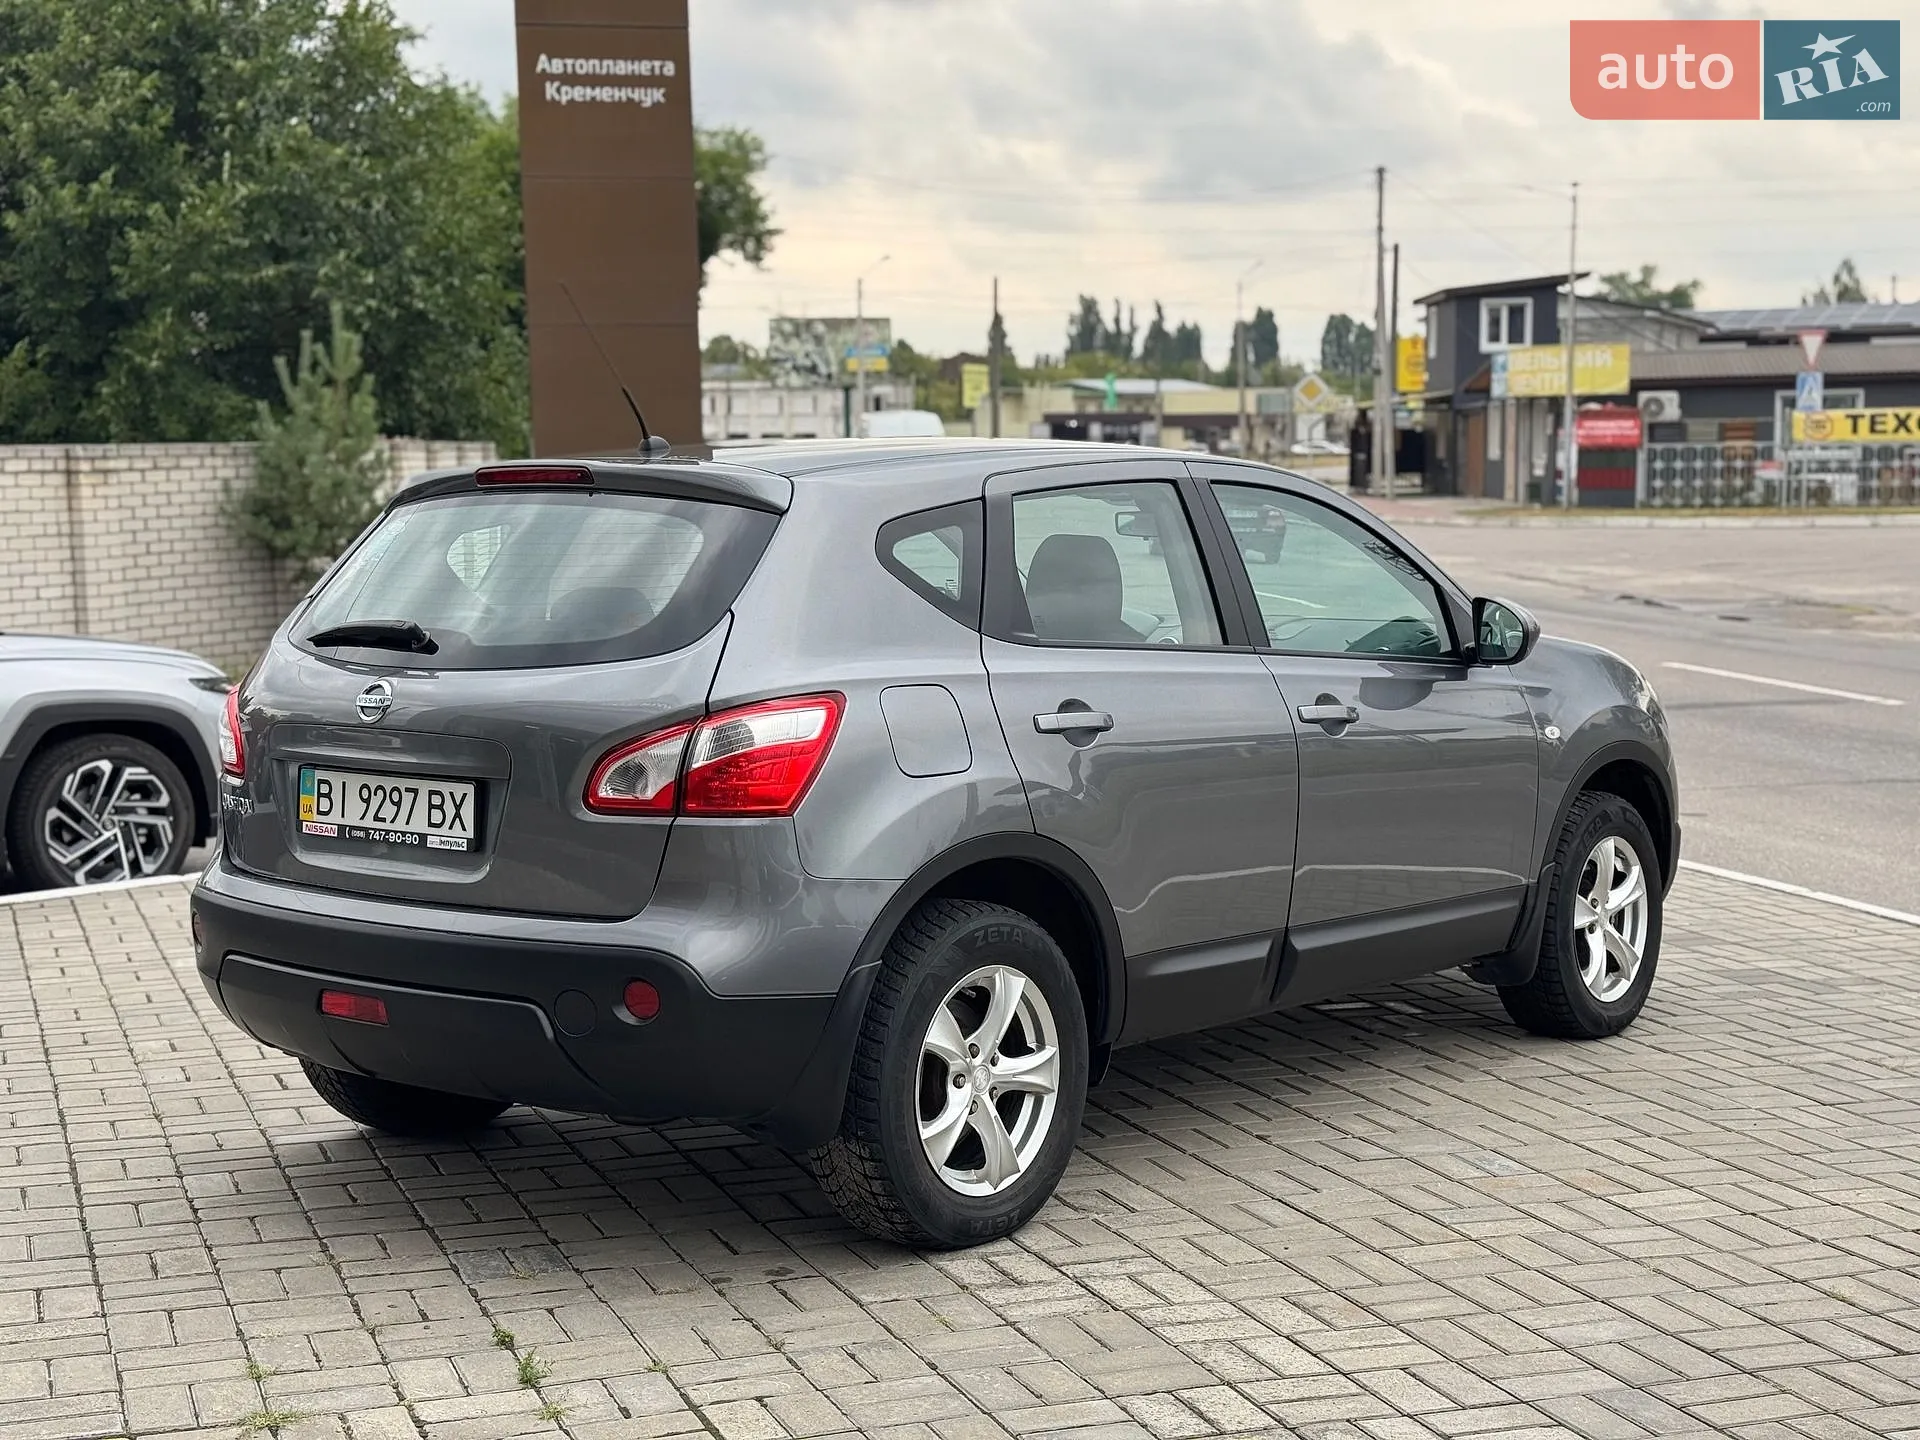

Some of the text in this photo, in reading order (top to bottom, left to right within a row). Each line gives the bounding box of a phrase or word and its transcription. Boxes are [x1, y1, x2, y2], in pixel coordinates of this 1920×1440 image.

[535, 53, 676, 77] Автопланета
[545, 81, 667, 108] Кременчук
[1845, 412, 1920, 435] ТЕХ
[302, 801, 313, 815] UA
[316, 778, 468, 832] BI 9297 BX
[304, 823, 337, 836] NISSAN
[368, 830, 420, 845] 747-90-90
[974, 926, 1024, 948] ZETA
